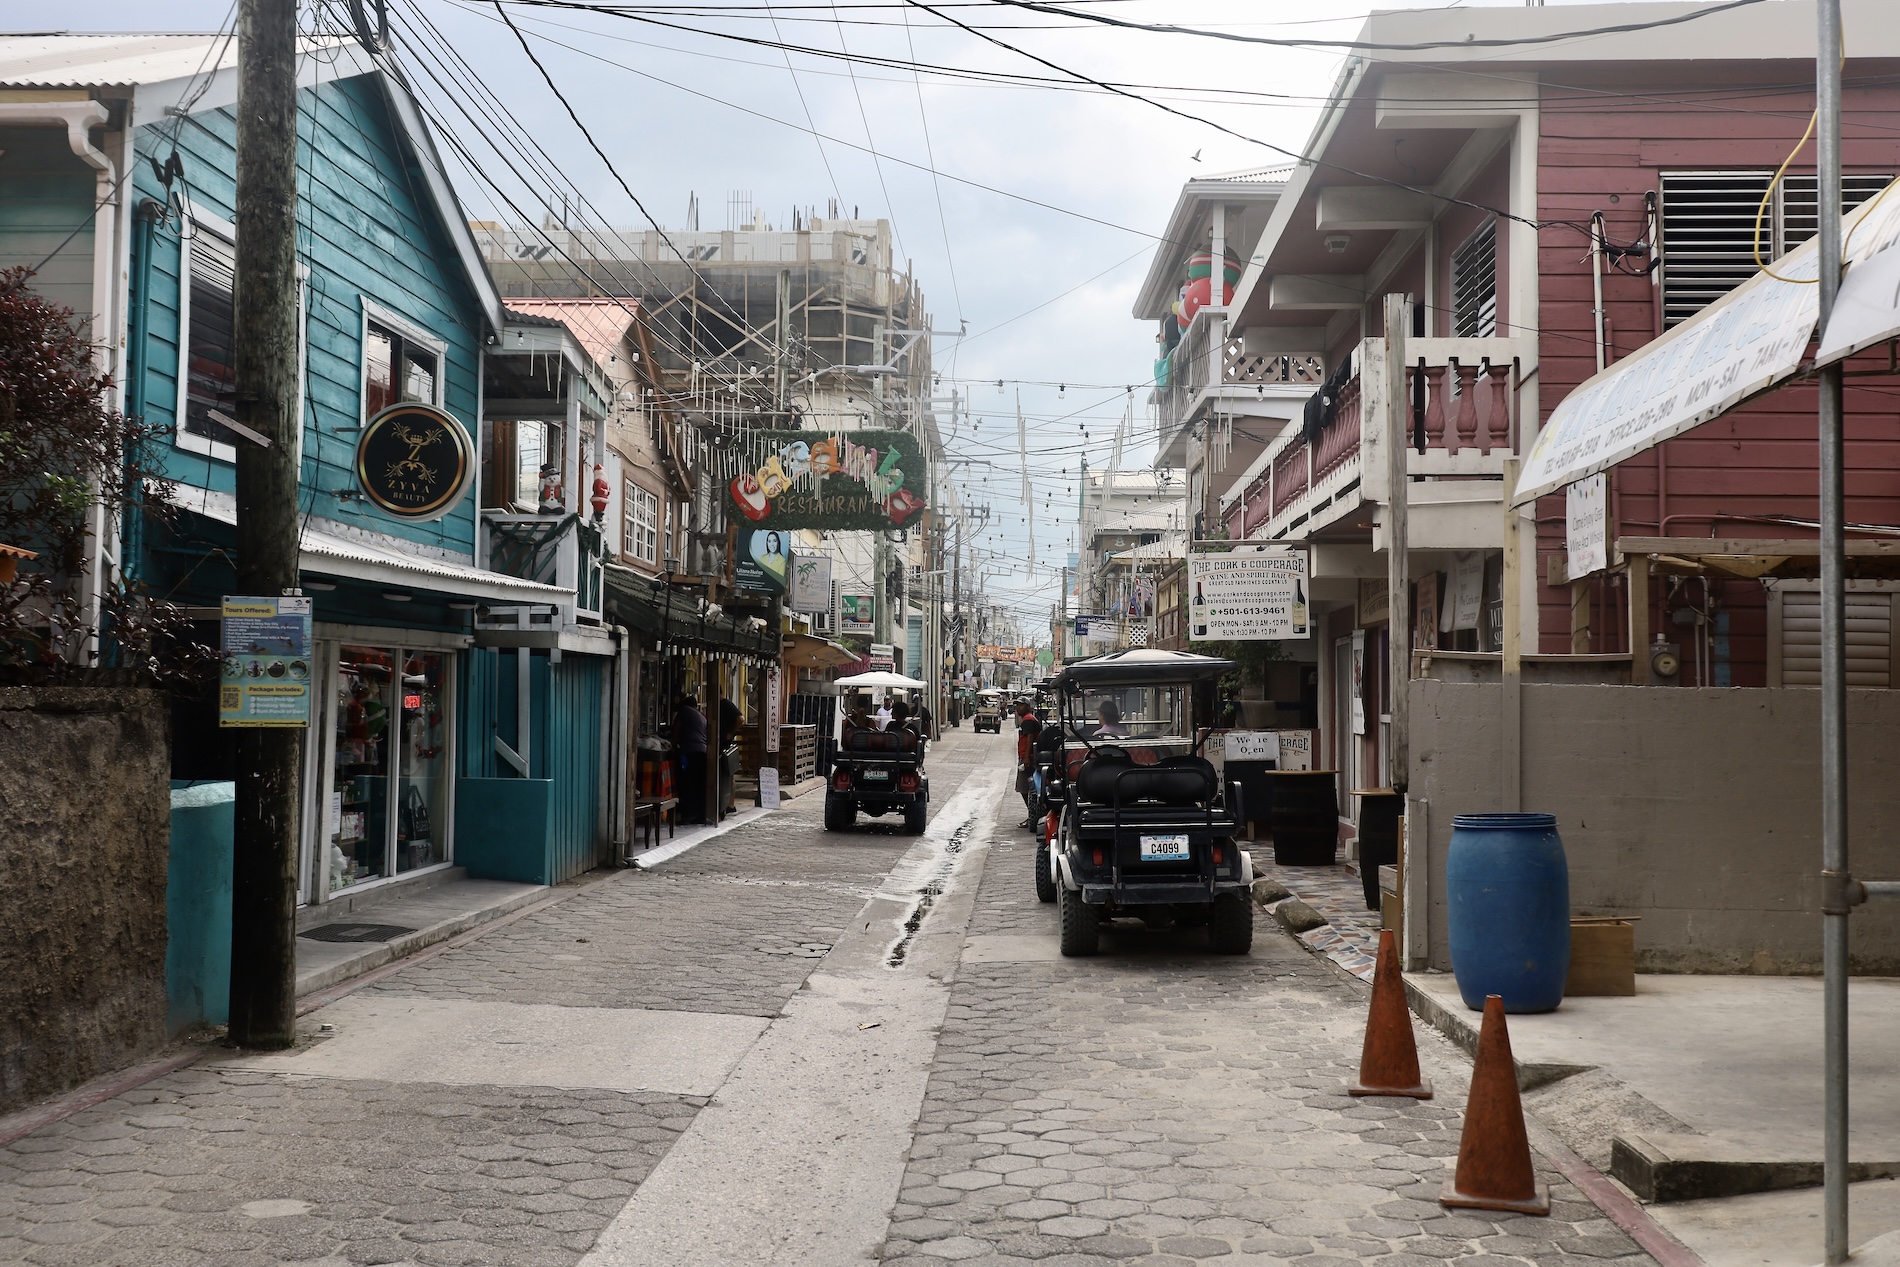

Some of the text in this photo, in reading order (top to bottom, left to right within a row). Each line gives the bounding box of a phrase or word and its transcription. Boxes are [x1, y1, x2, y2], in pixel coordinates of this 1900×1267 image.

[388, 479, 430, 494] ZYVA
[392, 492, 425, 503] BEAUTY
[777, 495, 881, 516] RESTAURANT
[1192, 558, 1304, 575] THE CORK & COOPERAGE
[1208, 571, 1286, 581] WINE AND SPIRIT BAR
[1207, 590, 1291, 598] www.corkandcooperage.com
[1207, 597, 1291, 605] sales@corkandcooperage.com
[1218, 606, 1286, 616] +501-613-9461
[1210, 620, 1226, 628] OPEN
[1226, 620, 1239, 628] MON
[1242, 619, 1255, 628] SAT:
[1255, 619, 1260, 627] 9
[1260, 619, 1269, 627] AM
[1272, 619, 1280, 627] 10
[1280, 618, 1289, 627] PM
[1222, 629, 1236, 637] SUN:
[1237, 629, 1249, 637] 1:30
[1249, 628, 1257, 636] PM
[1261, 628, 1268, 636] 10
[1268, 628, 1277, 636] PM
[1207, 737, 1309, 751] THE ERAGE
[1151, 842, 1179, 854] C4099
